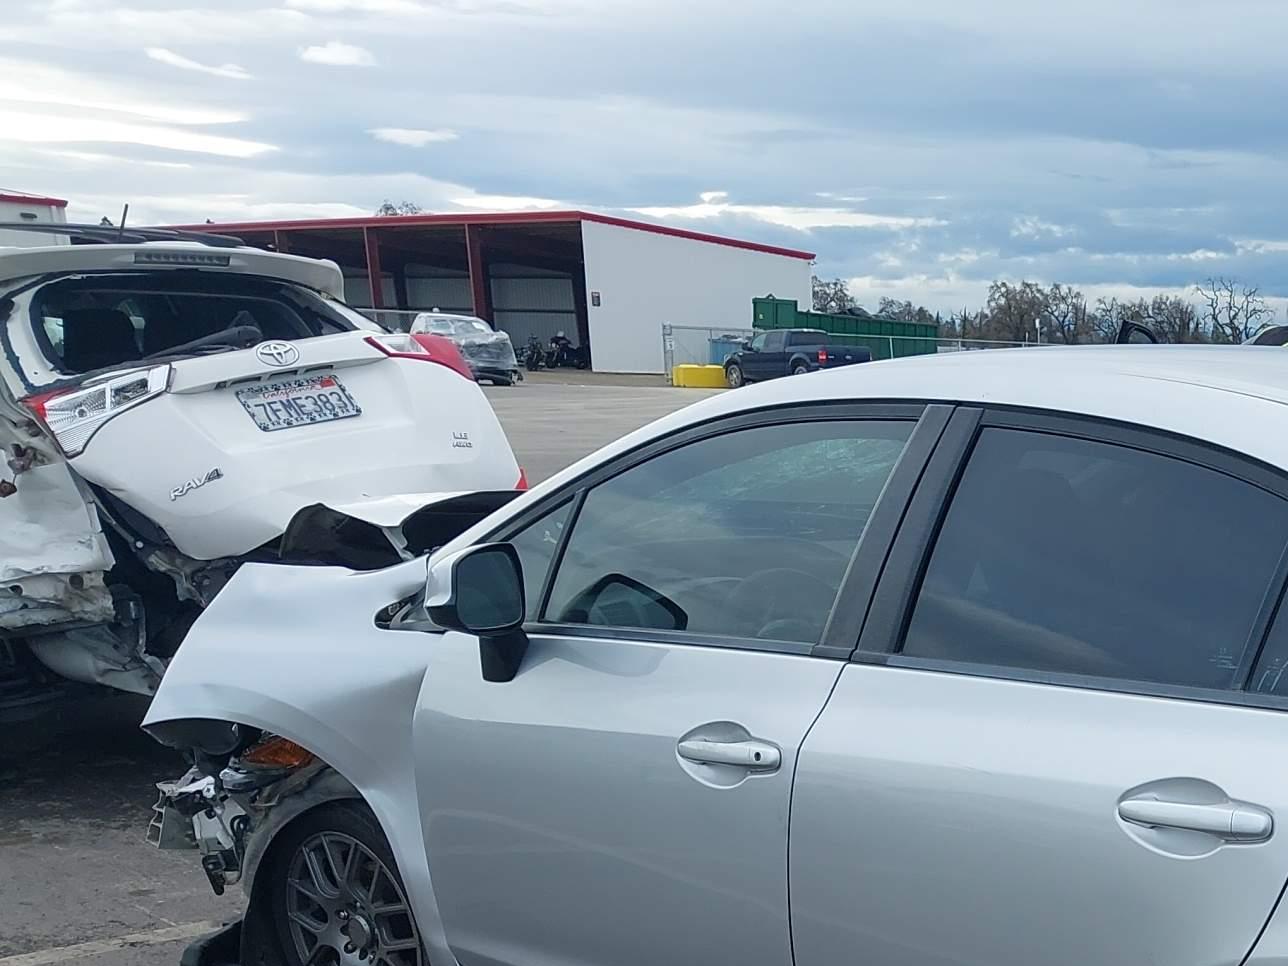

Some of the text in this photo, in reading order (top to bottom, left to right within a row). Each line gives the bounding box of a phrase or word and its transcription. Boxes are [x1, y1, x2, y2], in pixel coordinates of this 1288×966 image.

[254, 391, 348, 422] 7FME383
[451, 431, 469, 440] LE
[170, 466, 223, 501] RAV4
